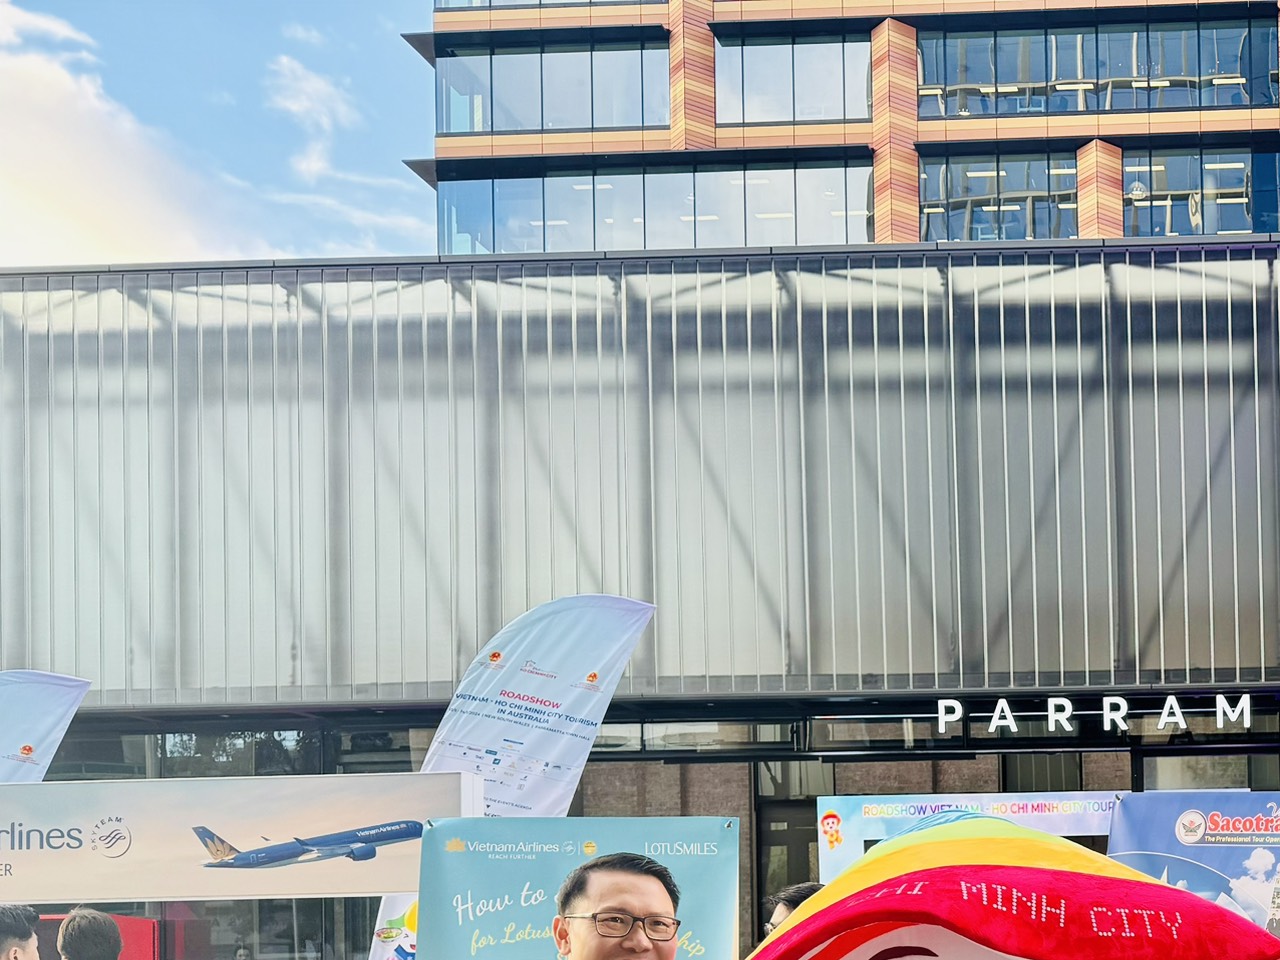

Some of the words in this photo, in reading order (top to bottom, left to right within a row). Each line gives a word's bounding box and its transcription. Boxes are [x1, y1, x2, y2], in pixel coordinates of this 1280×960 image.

[494, 699, 508, 707] HO
[509, 702, 523, 710] CHI
[524, 706, 546, 716] MINH
[547, 711, 563, 719] CITY
[500, 689, 562, 709] ROADSHOW
[507, 710, 549, 724] AUSTRALIA
[863, 804, 927, 817] ROADSHOW
[992, 803, 1008, 815] HO
[1010, 803, 1029, 814] CHI
[1031, 803, 1059, 814] MINH
[1061, 802, 1083, 813] CITY
[91, 816, 124, 851] SKYTEAM
[645, 841, 718, 855] LOTUSMILES
[452, 889, 513, 926] How
[520, 881, 548, 907] to
[960, 880, 1066, 927] MINH
[1089, 906, 1182, 939] CITY
[470, 928, 498, 956] for
